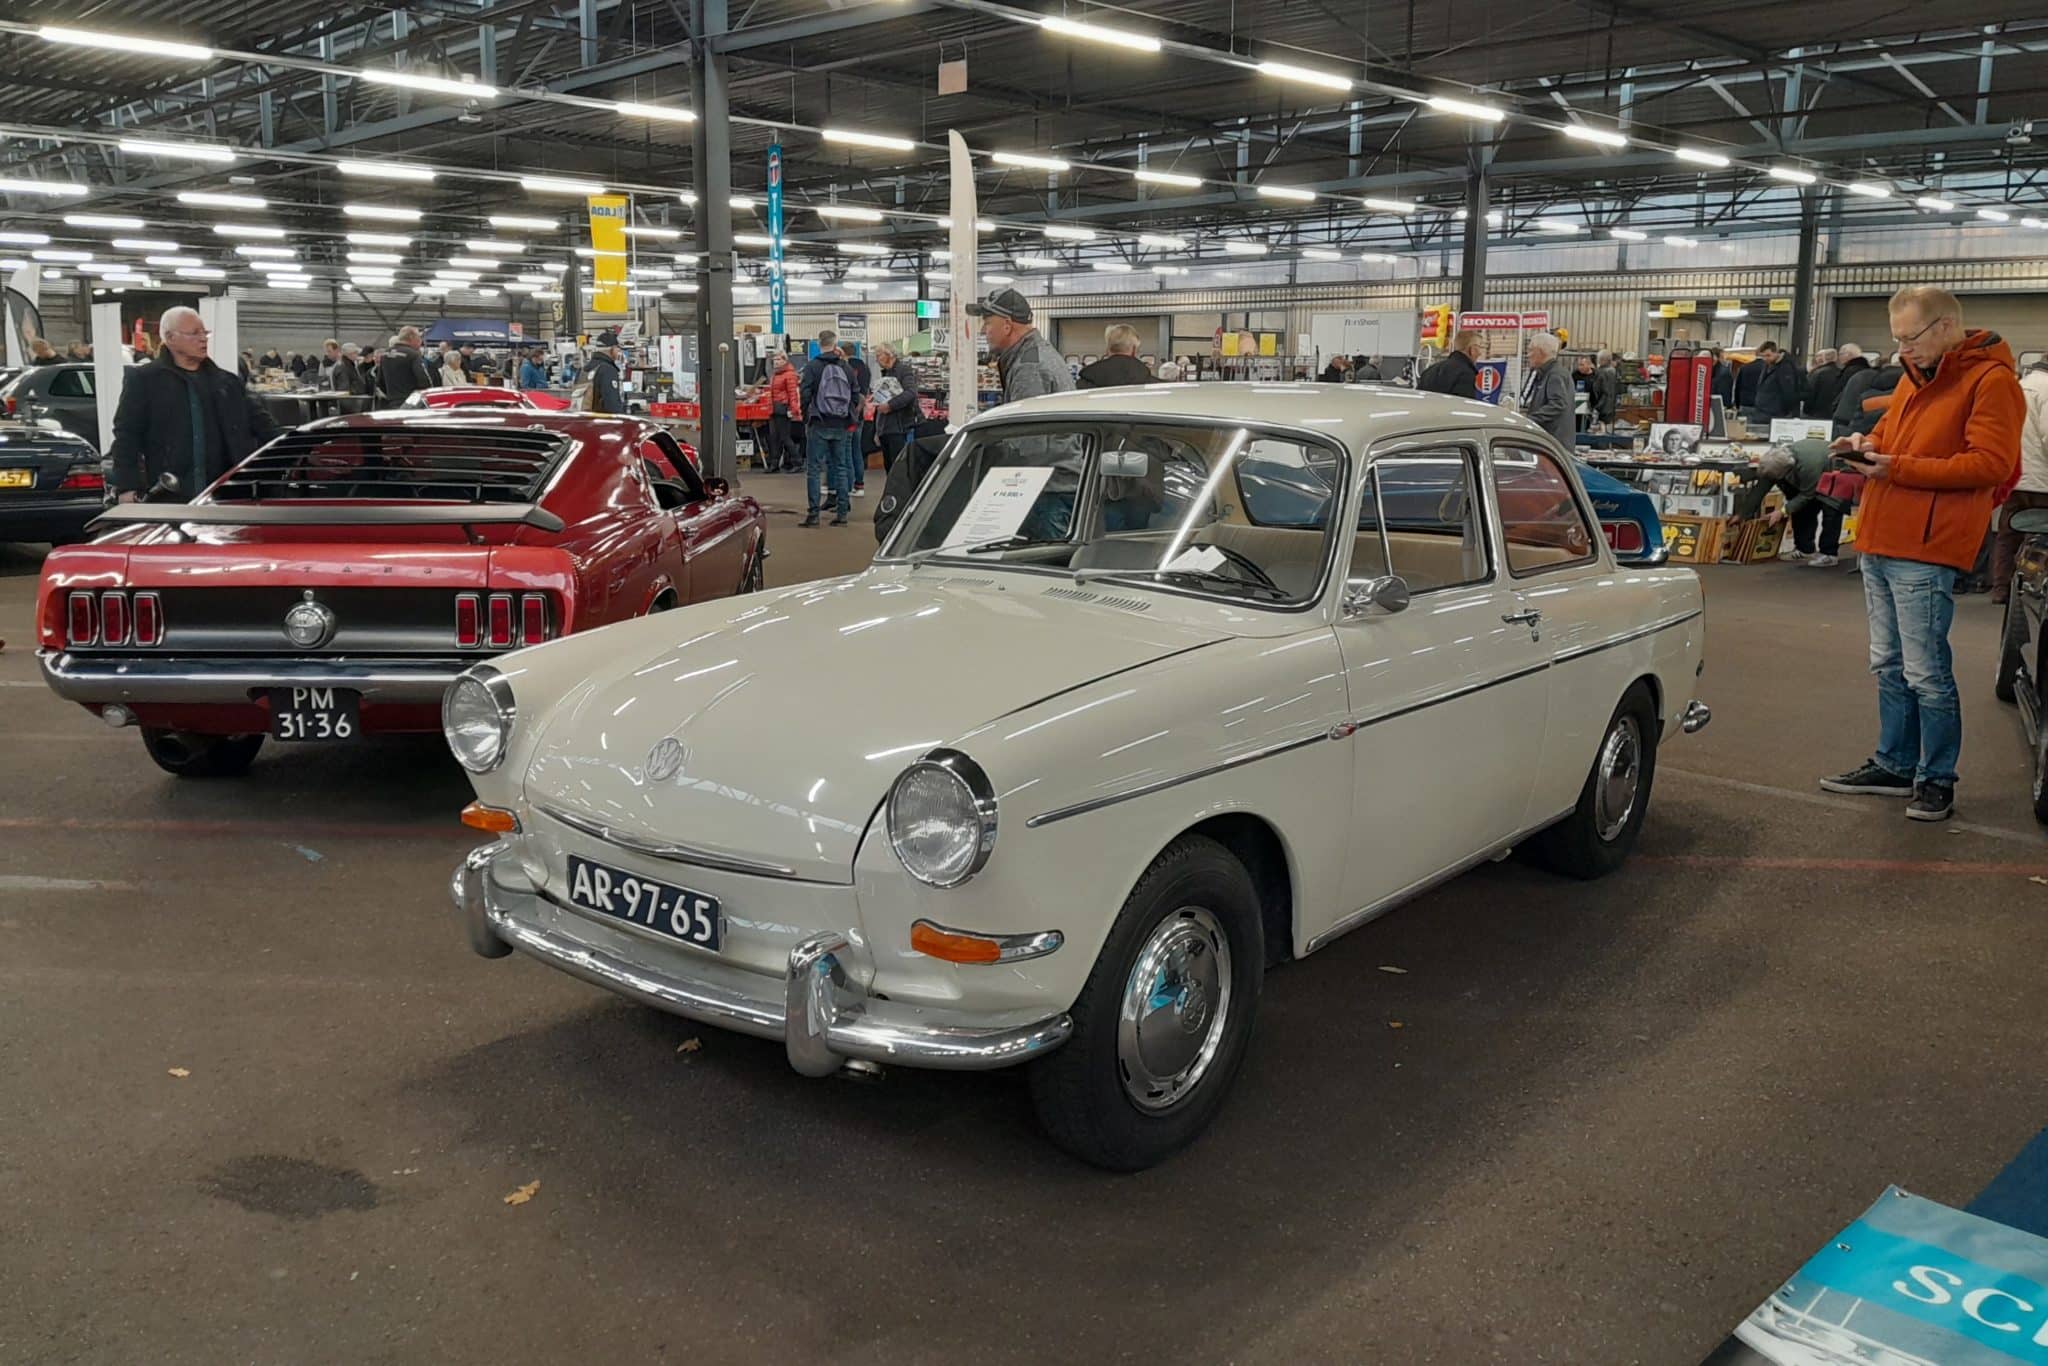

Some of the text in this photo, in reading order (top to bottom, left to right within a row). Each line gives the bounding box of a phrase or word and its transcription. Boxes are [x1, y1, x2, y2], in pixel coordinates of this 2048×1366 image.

[771, 193, 781, 325] TALBOT
[1462, 318, 1519, 326] HONDA
[1483, 368, 1492, 393] Gulf
[293, 688, 334, 709] PM
